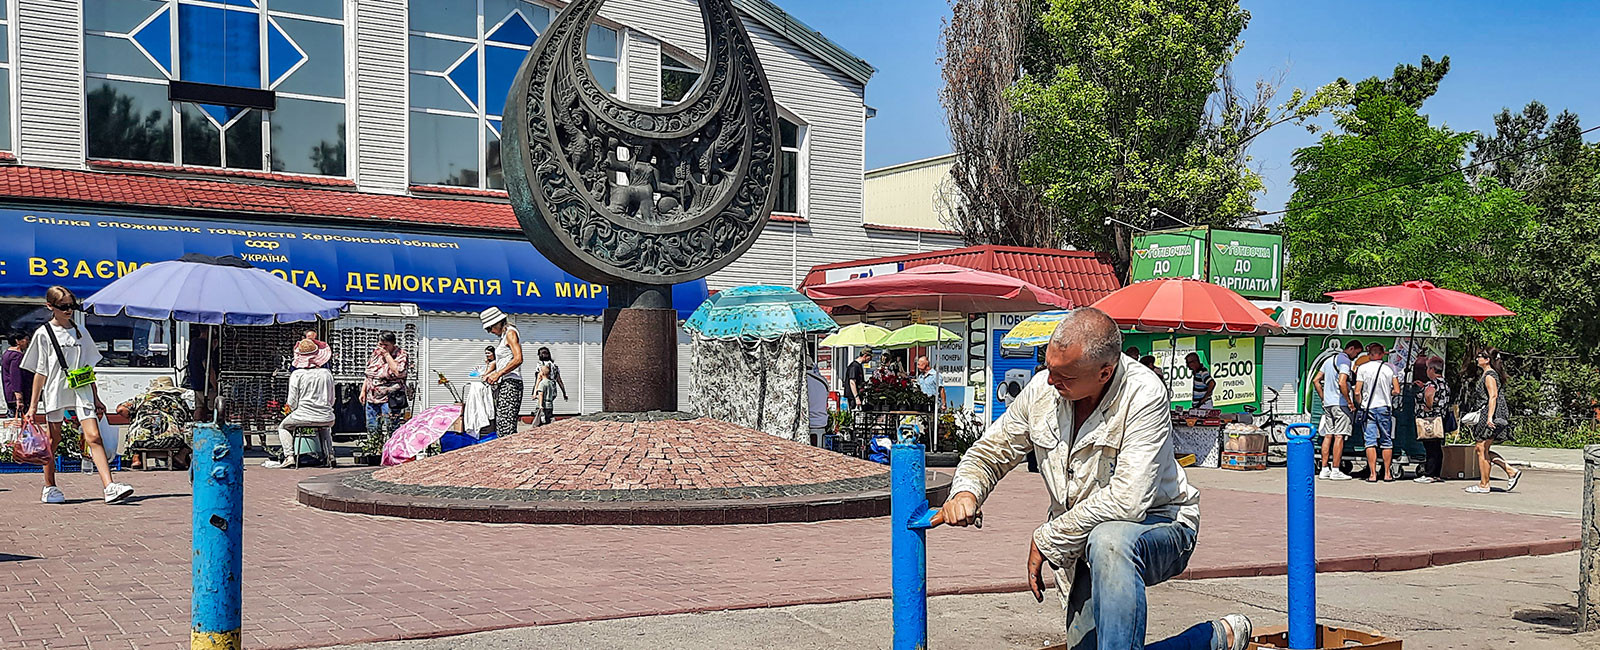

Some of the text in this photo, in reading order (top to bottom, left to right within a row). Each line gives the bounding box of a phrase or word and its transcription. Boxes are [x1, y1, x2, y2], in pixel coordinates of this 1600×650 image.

[23, 215, 460, 249] Спілка споживчих товариств Херсонської області
[240, 252, 288, 263] УКРАЇНА
[1153, 260, 1171, 276] ДО
[1233, 259, 1251, 274] ДО
[346, 271, 502, 296] ДЕМОКРАТІЯ
[512, 279, 541, 297] ТА
[1213, 275, 1270, 292] ЗАРПЛАТИ
[1290, 307, 1338, 329] Ваша
[1213, 360, 1253, 378] 25000
[1222, 389, 1234, 400] 20
